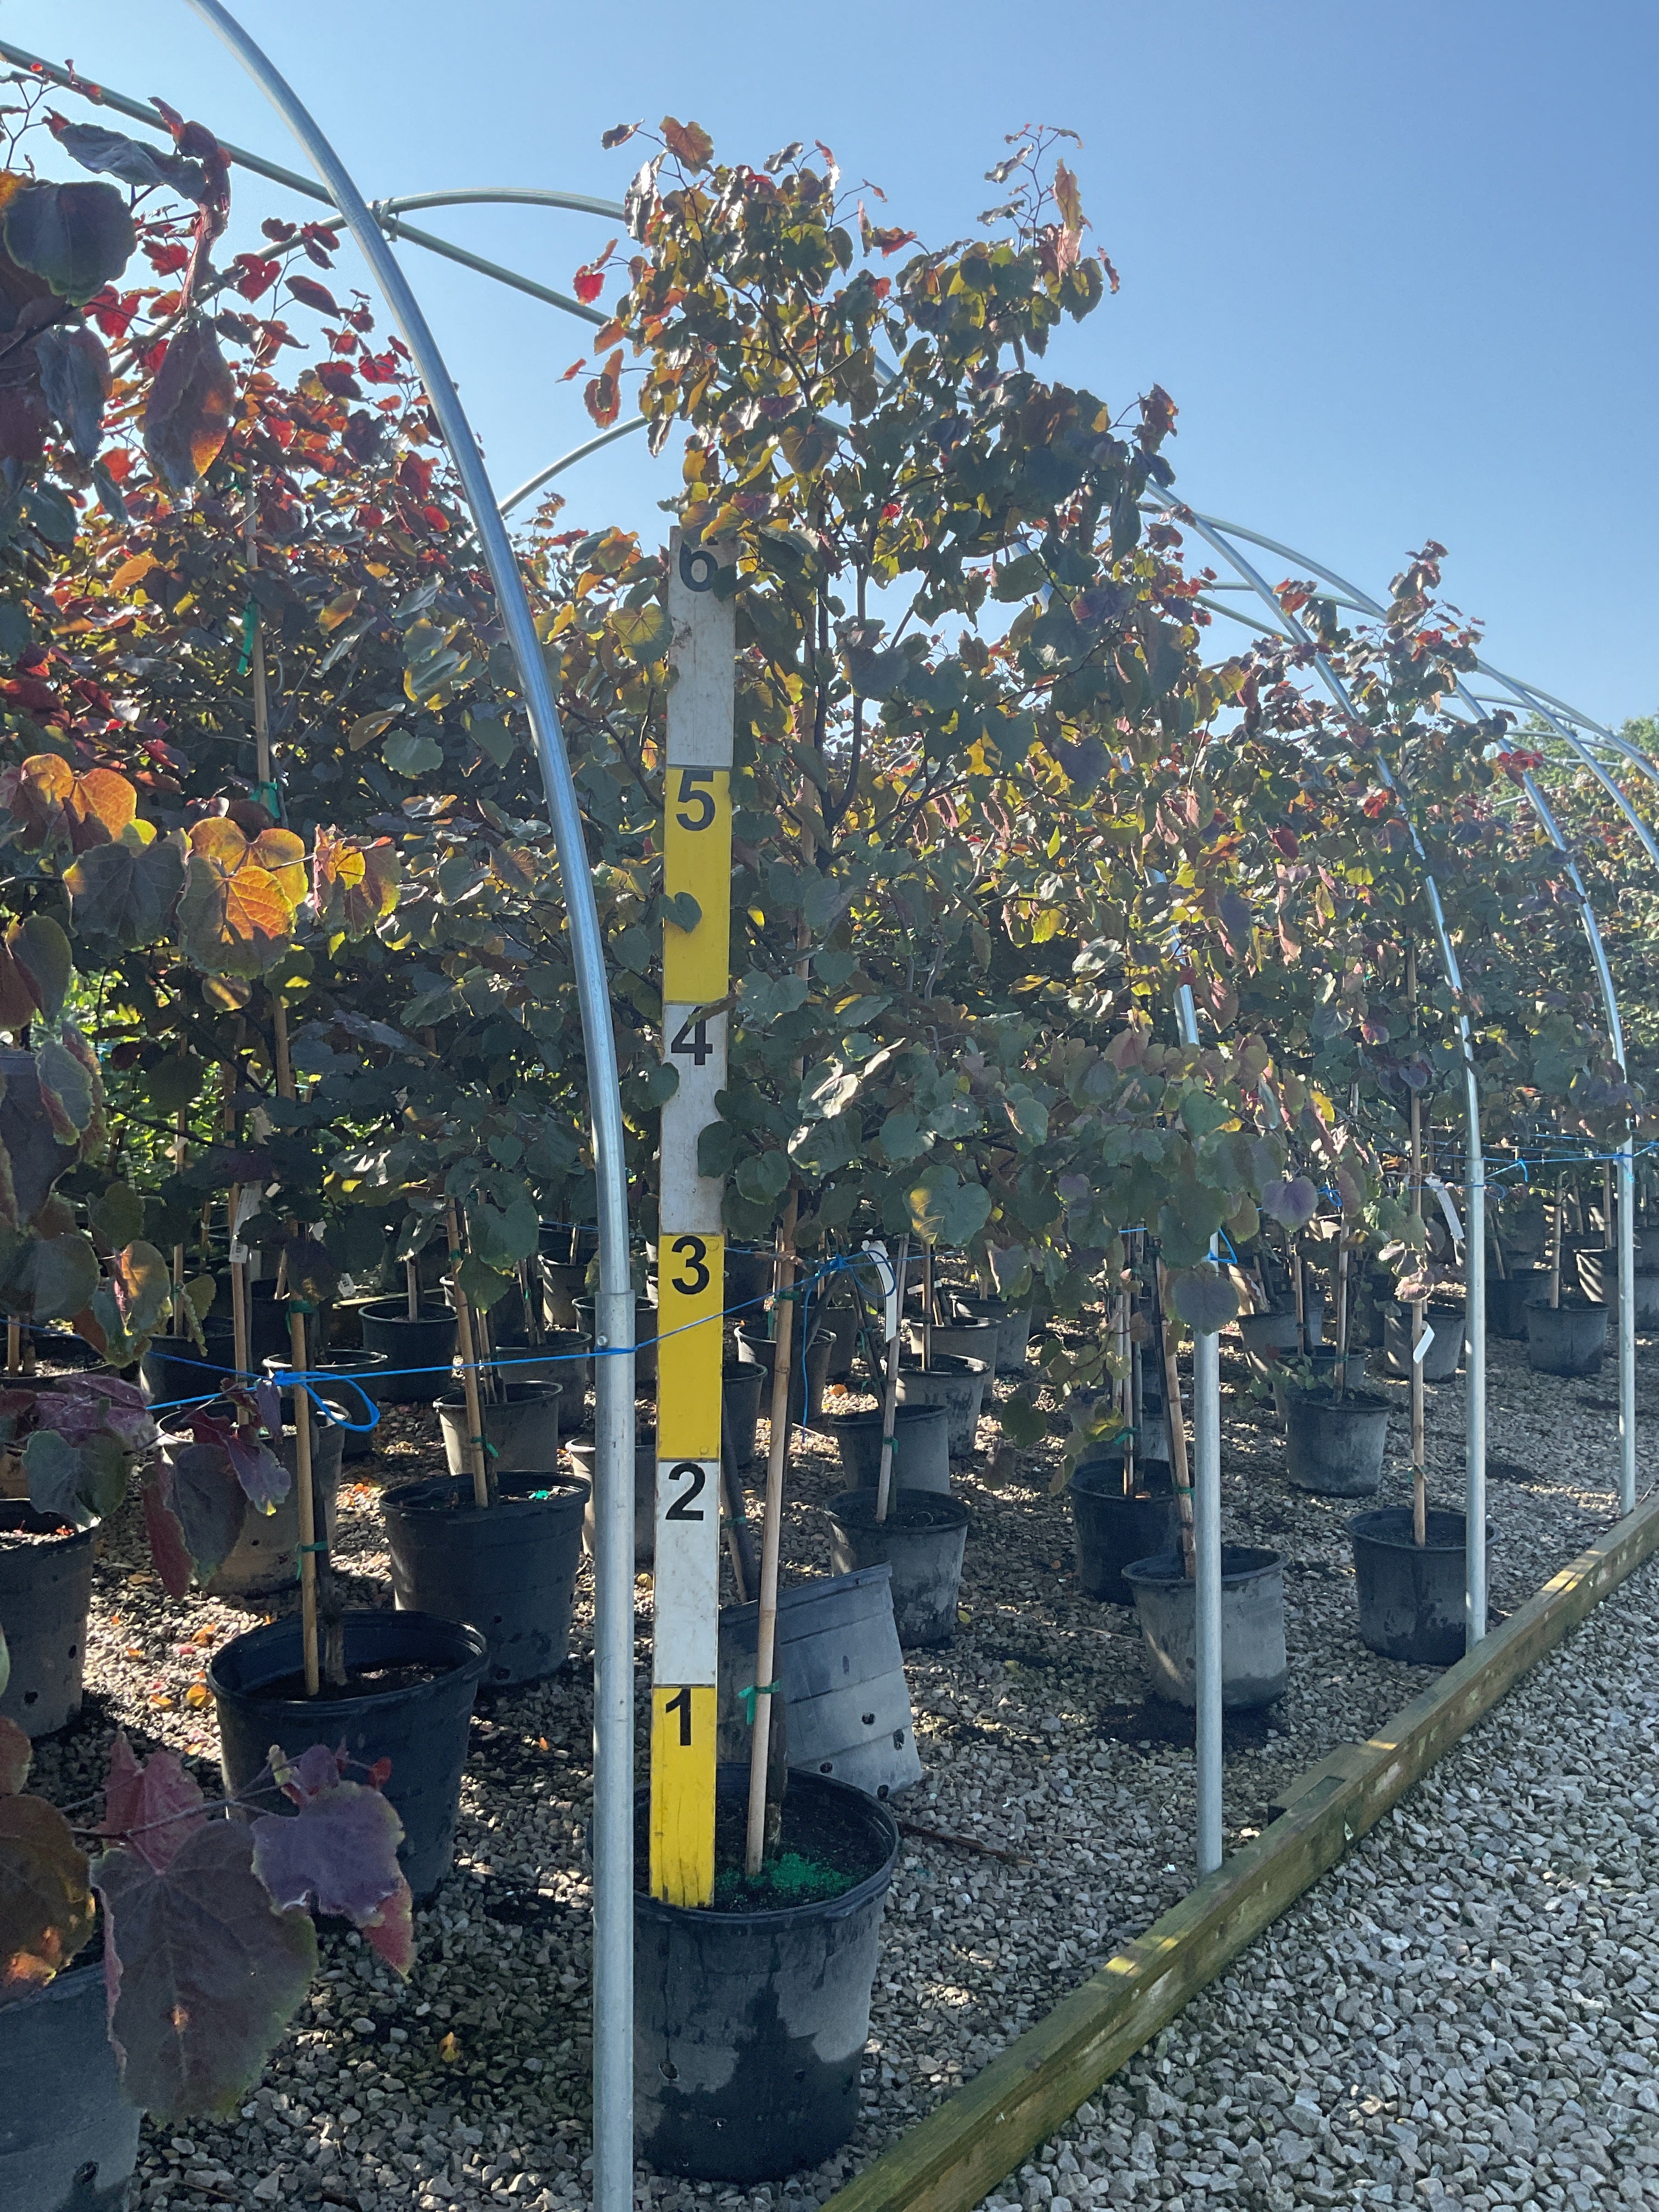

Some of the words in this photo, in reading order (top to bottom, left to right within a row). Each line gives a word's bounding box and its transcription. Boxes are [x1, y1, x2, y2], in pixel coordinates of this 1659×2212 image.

[679, 538, 719, 592] 6
[676, 770, 715, 831] 5
[671, 1006, 713, 1065] 4
[672, 1236, 710, 1295] 3
[665, 1463, 706, 1520] 2
[665, 1688, 691, 1746] 1
